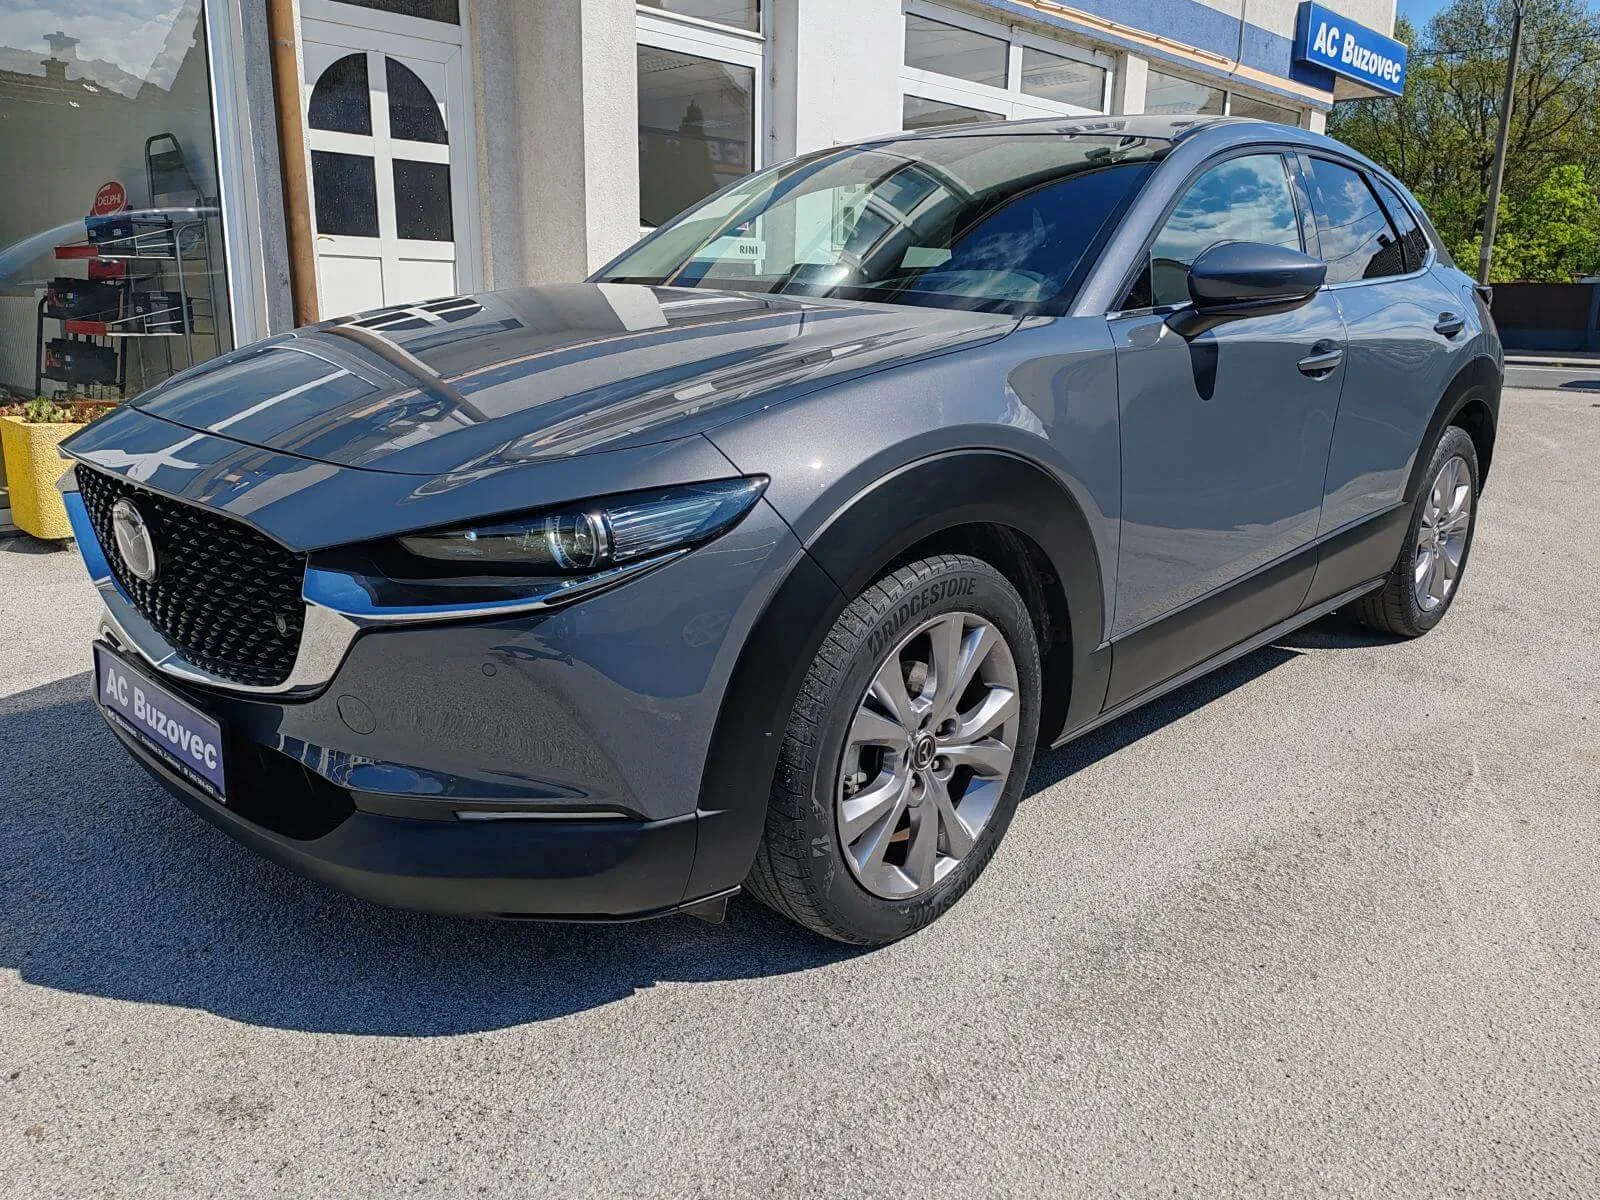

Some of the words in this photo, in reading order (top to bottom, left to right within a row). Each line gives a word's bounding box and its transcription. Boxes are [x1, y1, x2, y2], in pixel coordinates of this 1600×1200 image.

[1313, 22, 1340, 57] AC
[1341, 33, 1402, 83] Buzovec
[97, 193, 121, 206] DELPHI
[867, 577, 977, 660] BRIDGESTONE
[106, 668, 129, 707] AC
[134, 687, 217, 769] Buzovec
